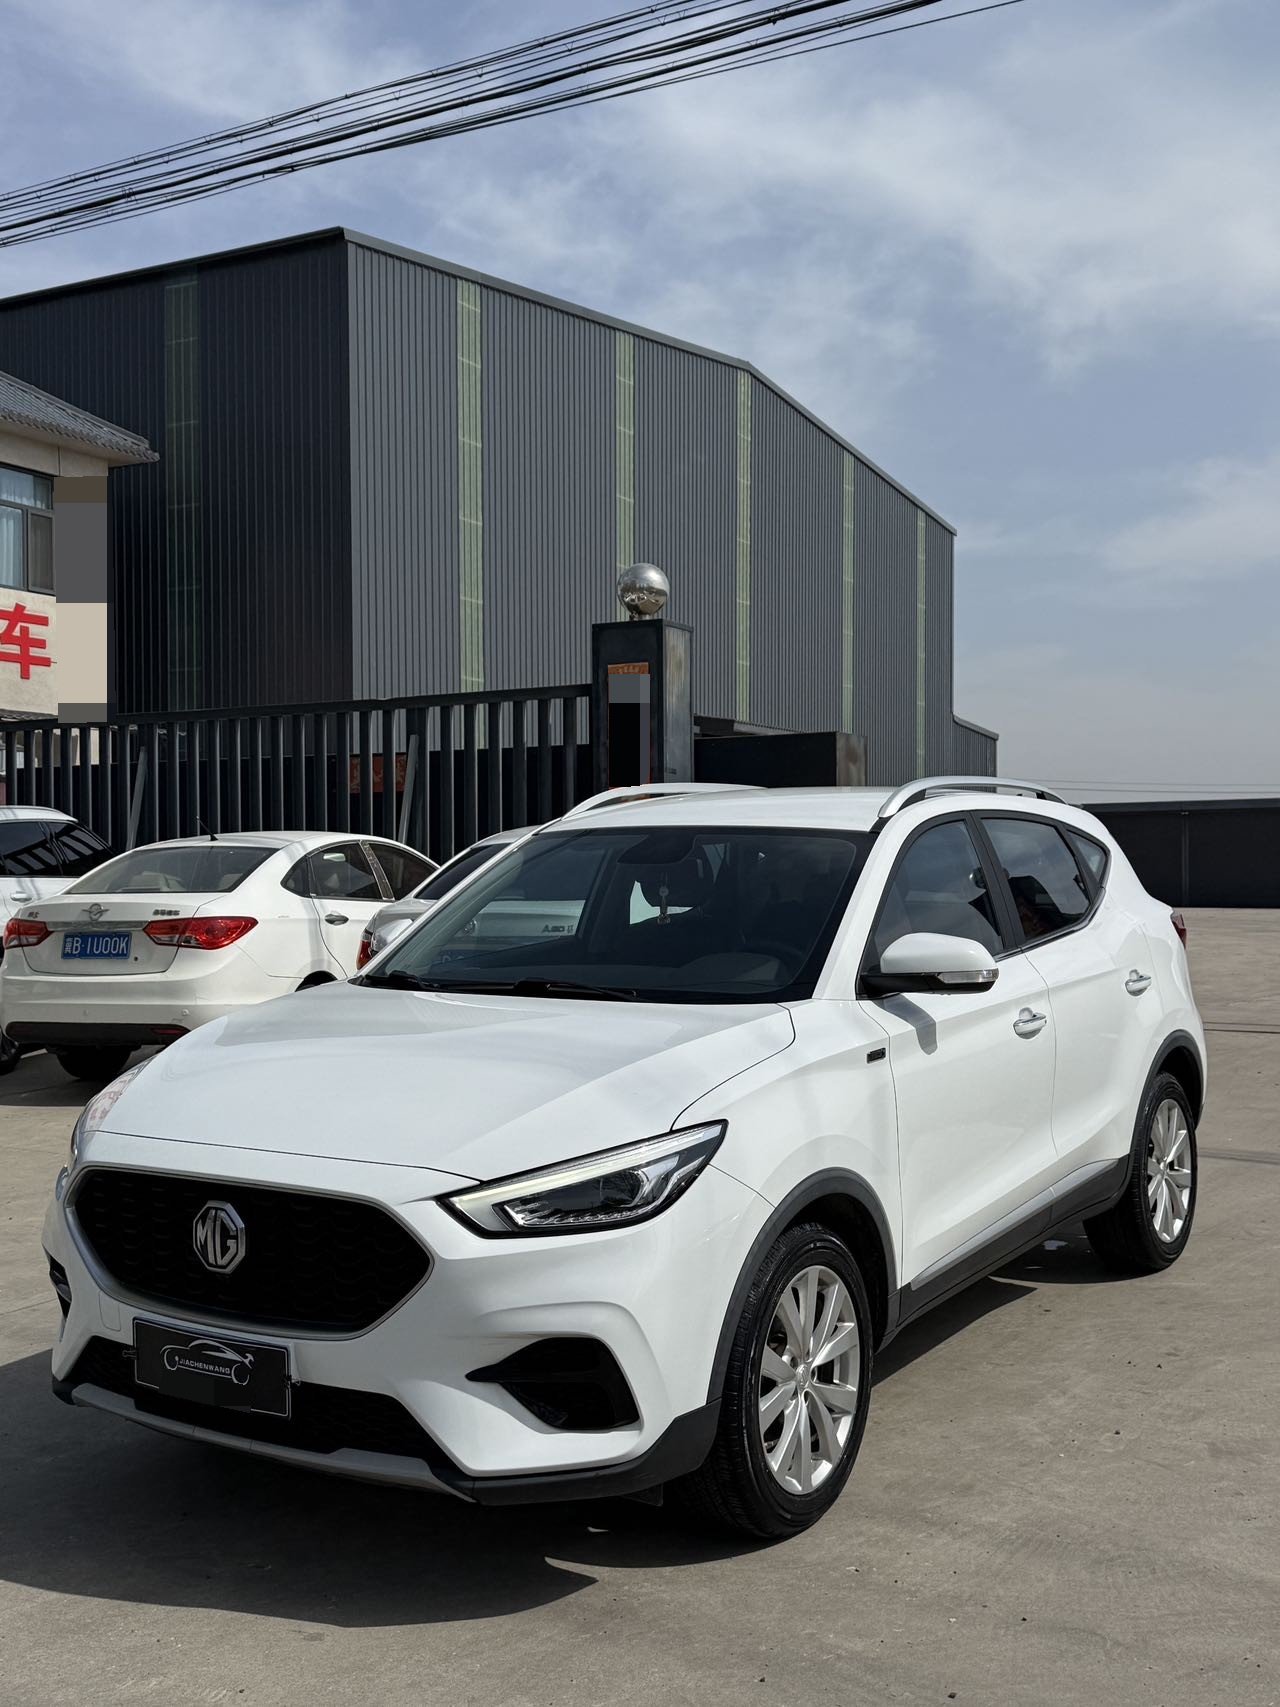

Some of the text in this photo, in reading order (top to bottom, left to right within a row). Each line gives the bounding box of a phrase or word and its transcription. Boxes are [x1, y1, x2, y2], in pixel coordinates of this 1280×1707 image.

[0, 602, 51, 680] 车
[197, 1209, 237, 1266] MG
[180, 1358, 231, 1374] JIACHENWANG
